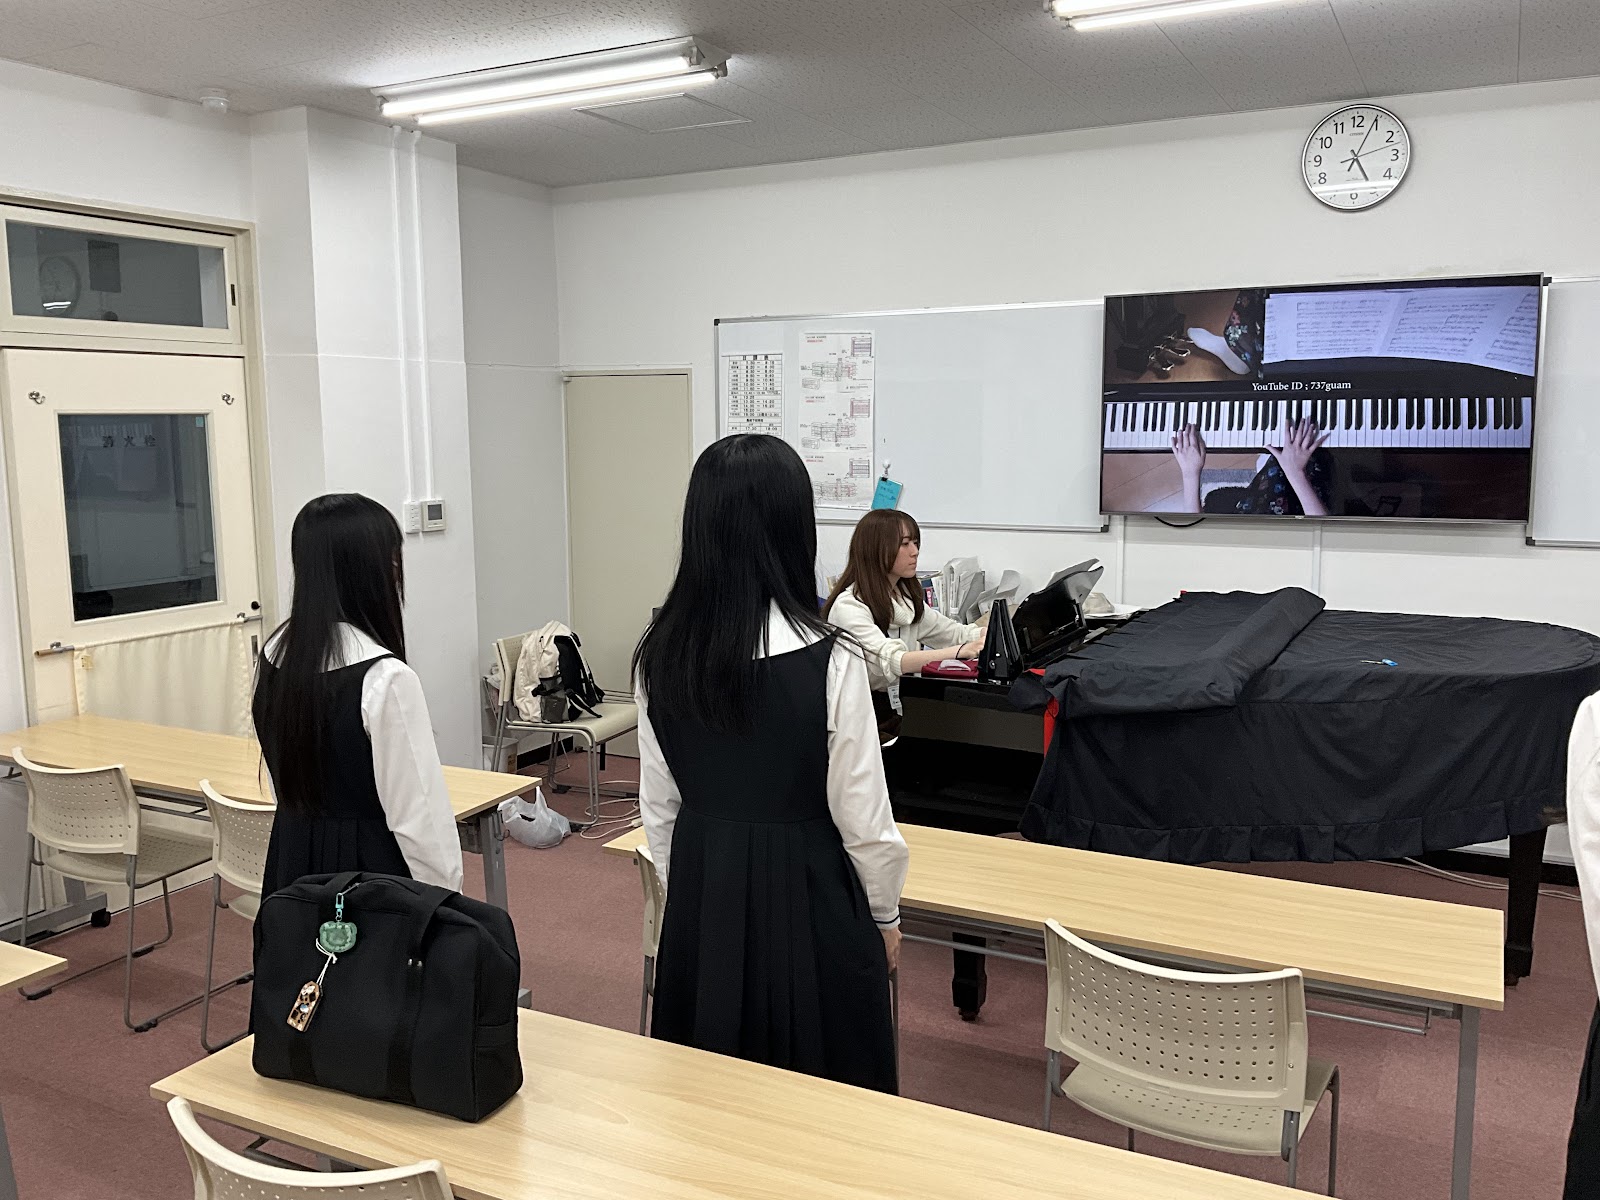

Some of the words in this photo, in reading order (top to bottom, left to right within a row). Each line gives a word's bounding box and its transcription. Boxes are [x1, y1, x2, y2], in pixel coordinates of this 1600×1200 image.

[1333, 122, 1344, 134] 11
[1350, 115, 1365, 128] 12
[1319, 136, 1333, 149] 10
[1385, 130, 1395, 143] 2
[1313, 154, 1322, 167] 9
[1390, 148, 1399, 161] 3
[1318, 172, 1327, 184] 8
[1382, 167, 1393, 180] 4
[1252, 382, 1289, 391] YouTube
[1291, 382, 1303, 390] ID
[1310, 382, 1352, 392] 737guam
[102, 434, 156, 448] 消火栓
